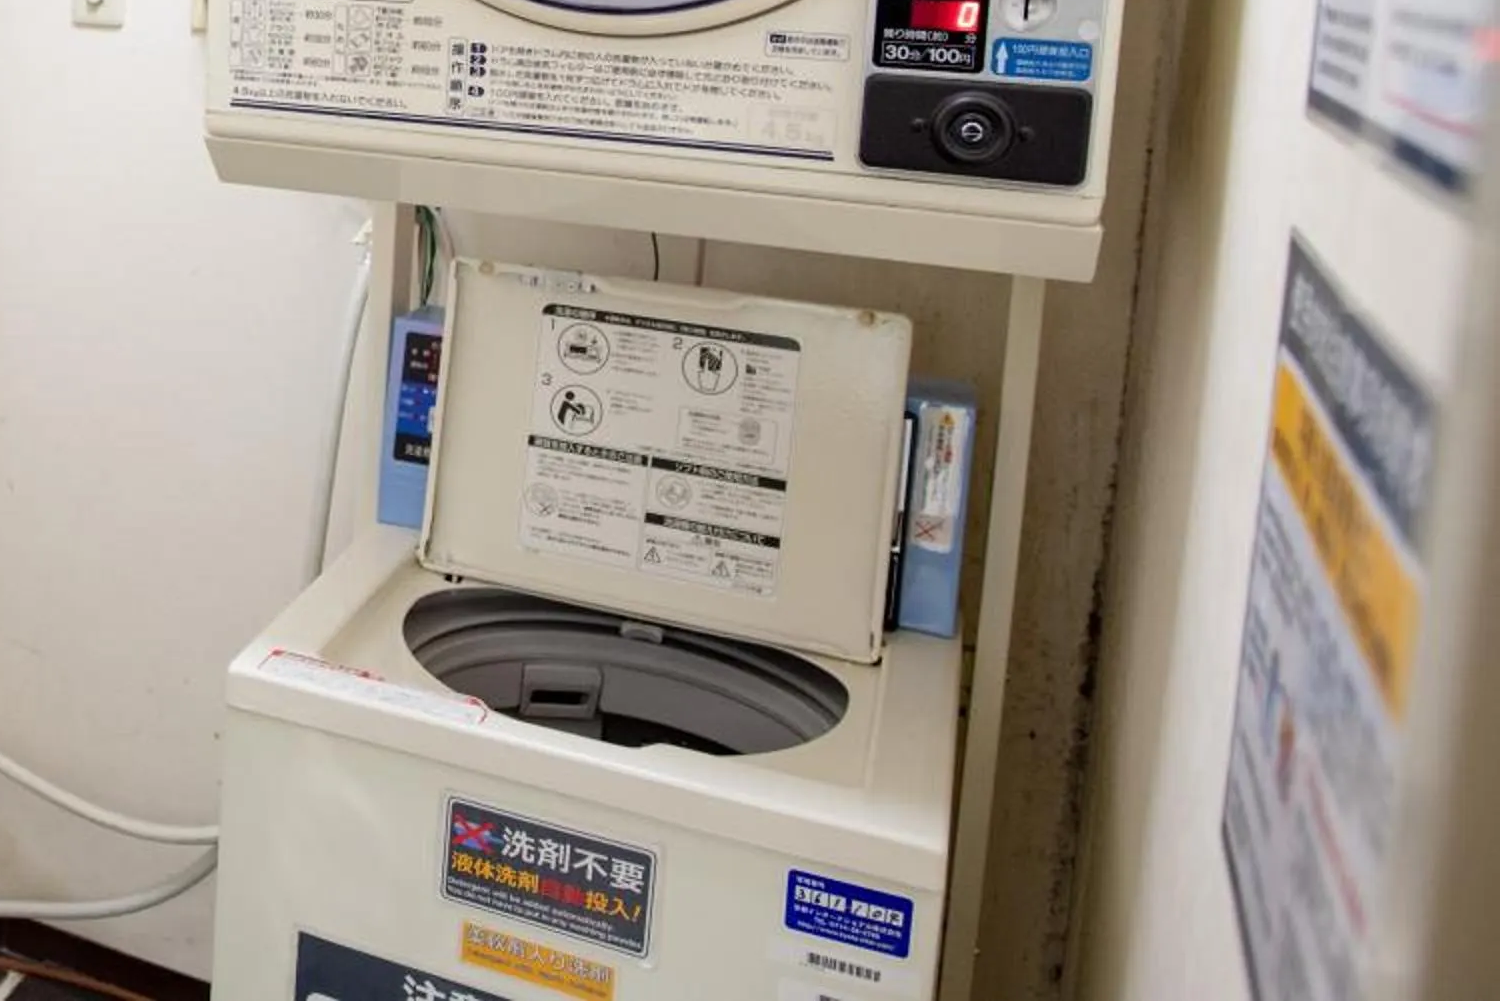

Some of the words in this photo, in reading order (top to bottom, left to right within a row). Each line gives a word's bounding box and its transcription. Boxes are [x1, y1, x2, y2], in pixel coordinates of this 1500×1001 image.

[958, 2, 980, 28] 0
[500, 825, 645, 895] 洗剤不要
